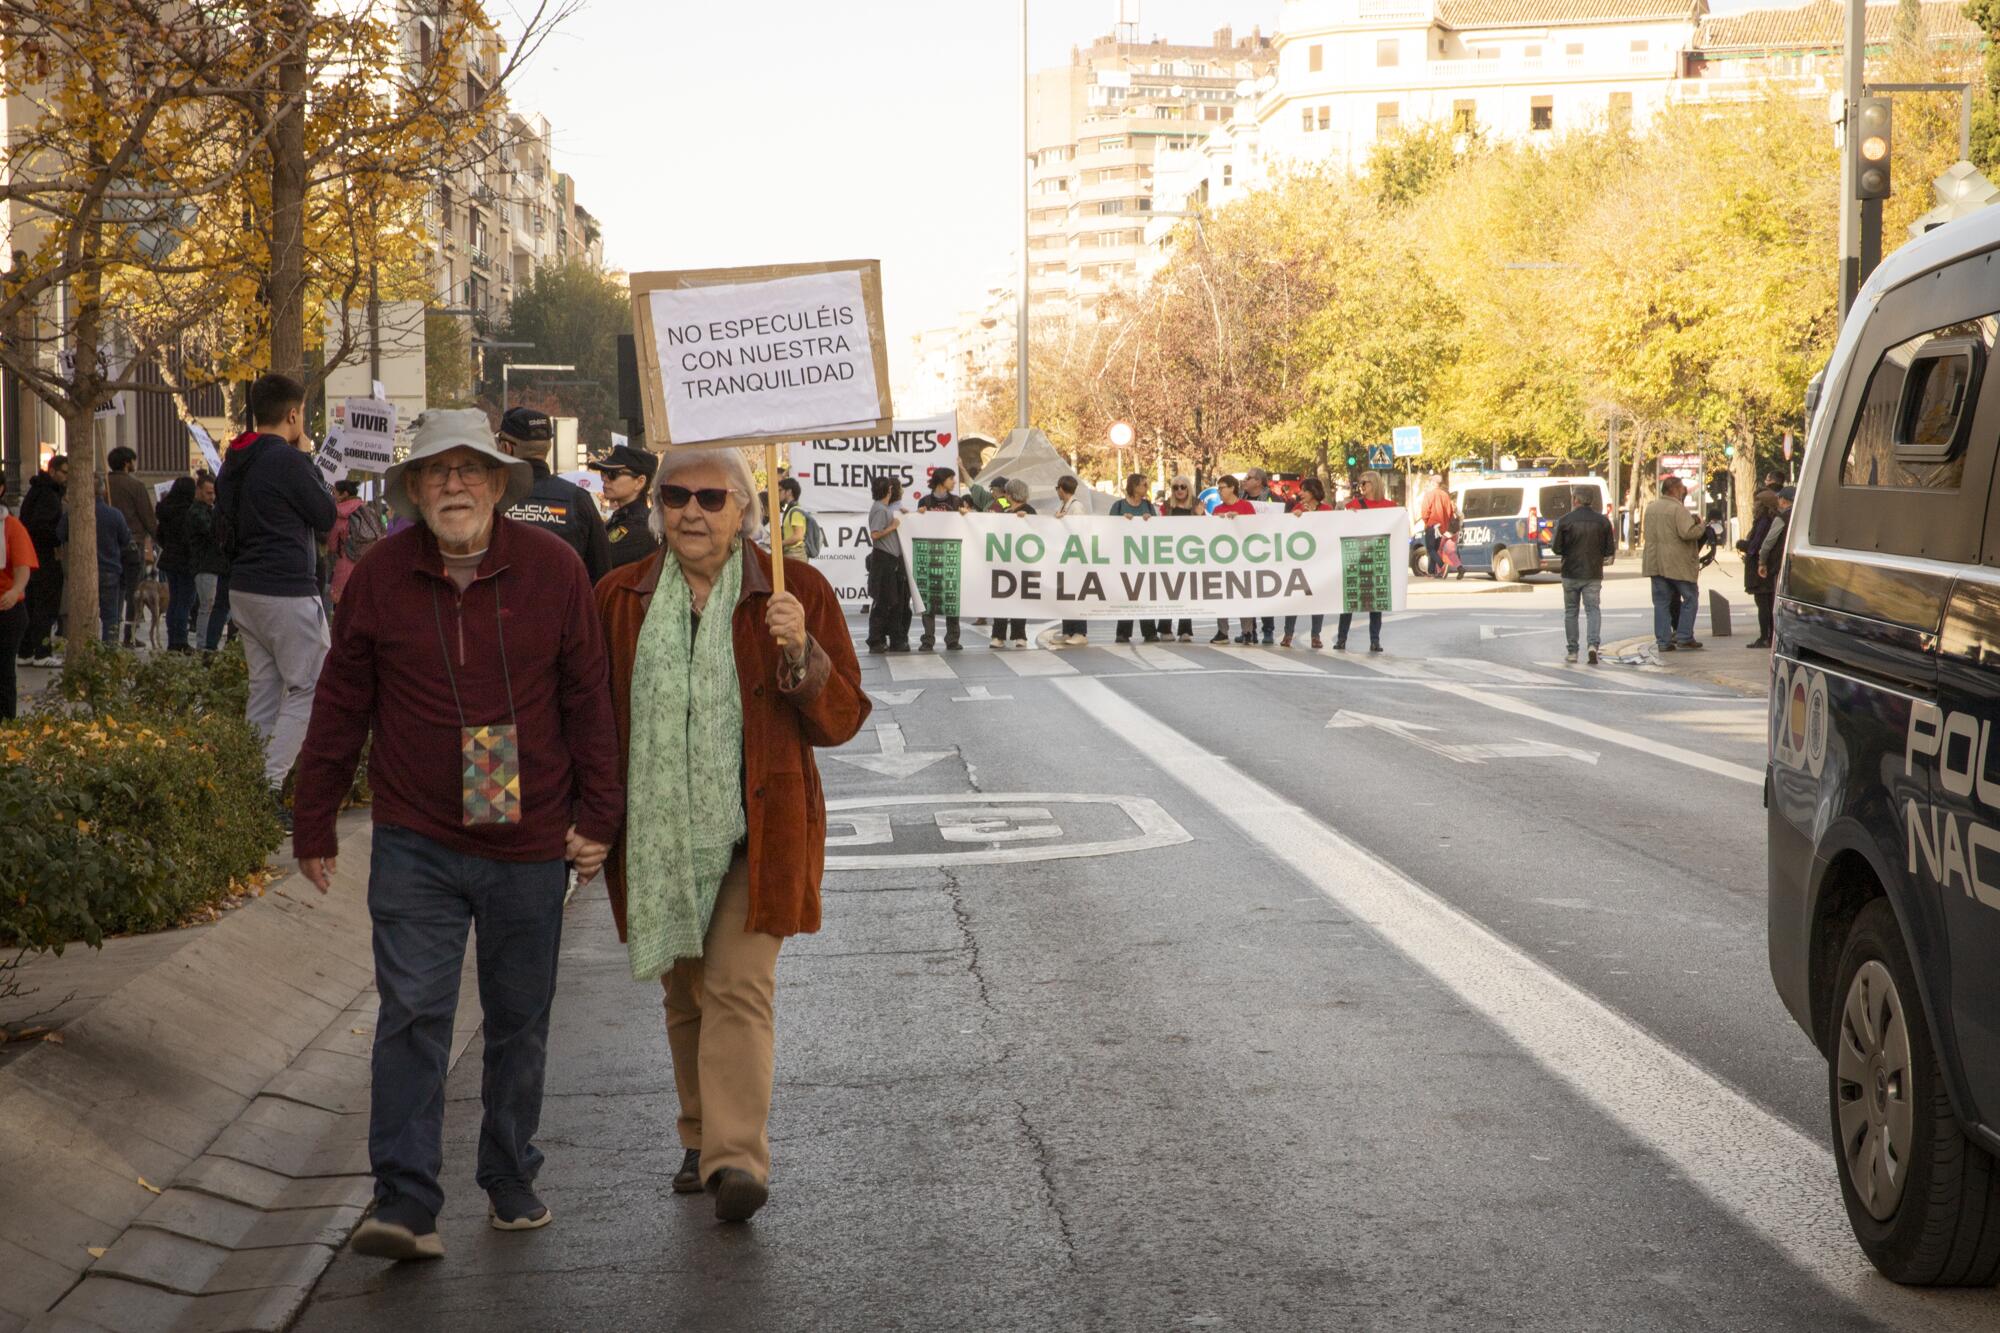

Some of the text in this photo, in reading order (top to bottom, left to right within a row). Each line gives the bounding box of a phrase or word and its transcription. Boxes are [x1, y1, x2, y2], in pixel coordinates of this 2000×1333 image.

[668, 305, 854, 346] NO ESPECULÉIS
[682, 335, 850, 371] CON NUESTRA
[682, 362, 854, 399] TRANQUILIDAD
[351, 412, 388, 433] VIVIR
[317, 456, 338, 474] PAGAR
[344, 448, 390, 463] SOBREVIVIR
[985, 531, 1317, 565] NO AL NEGOCIO
[991, 568, 1313, 601] DE LA VIVIENDA
